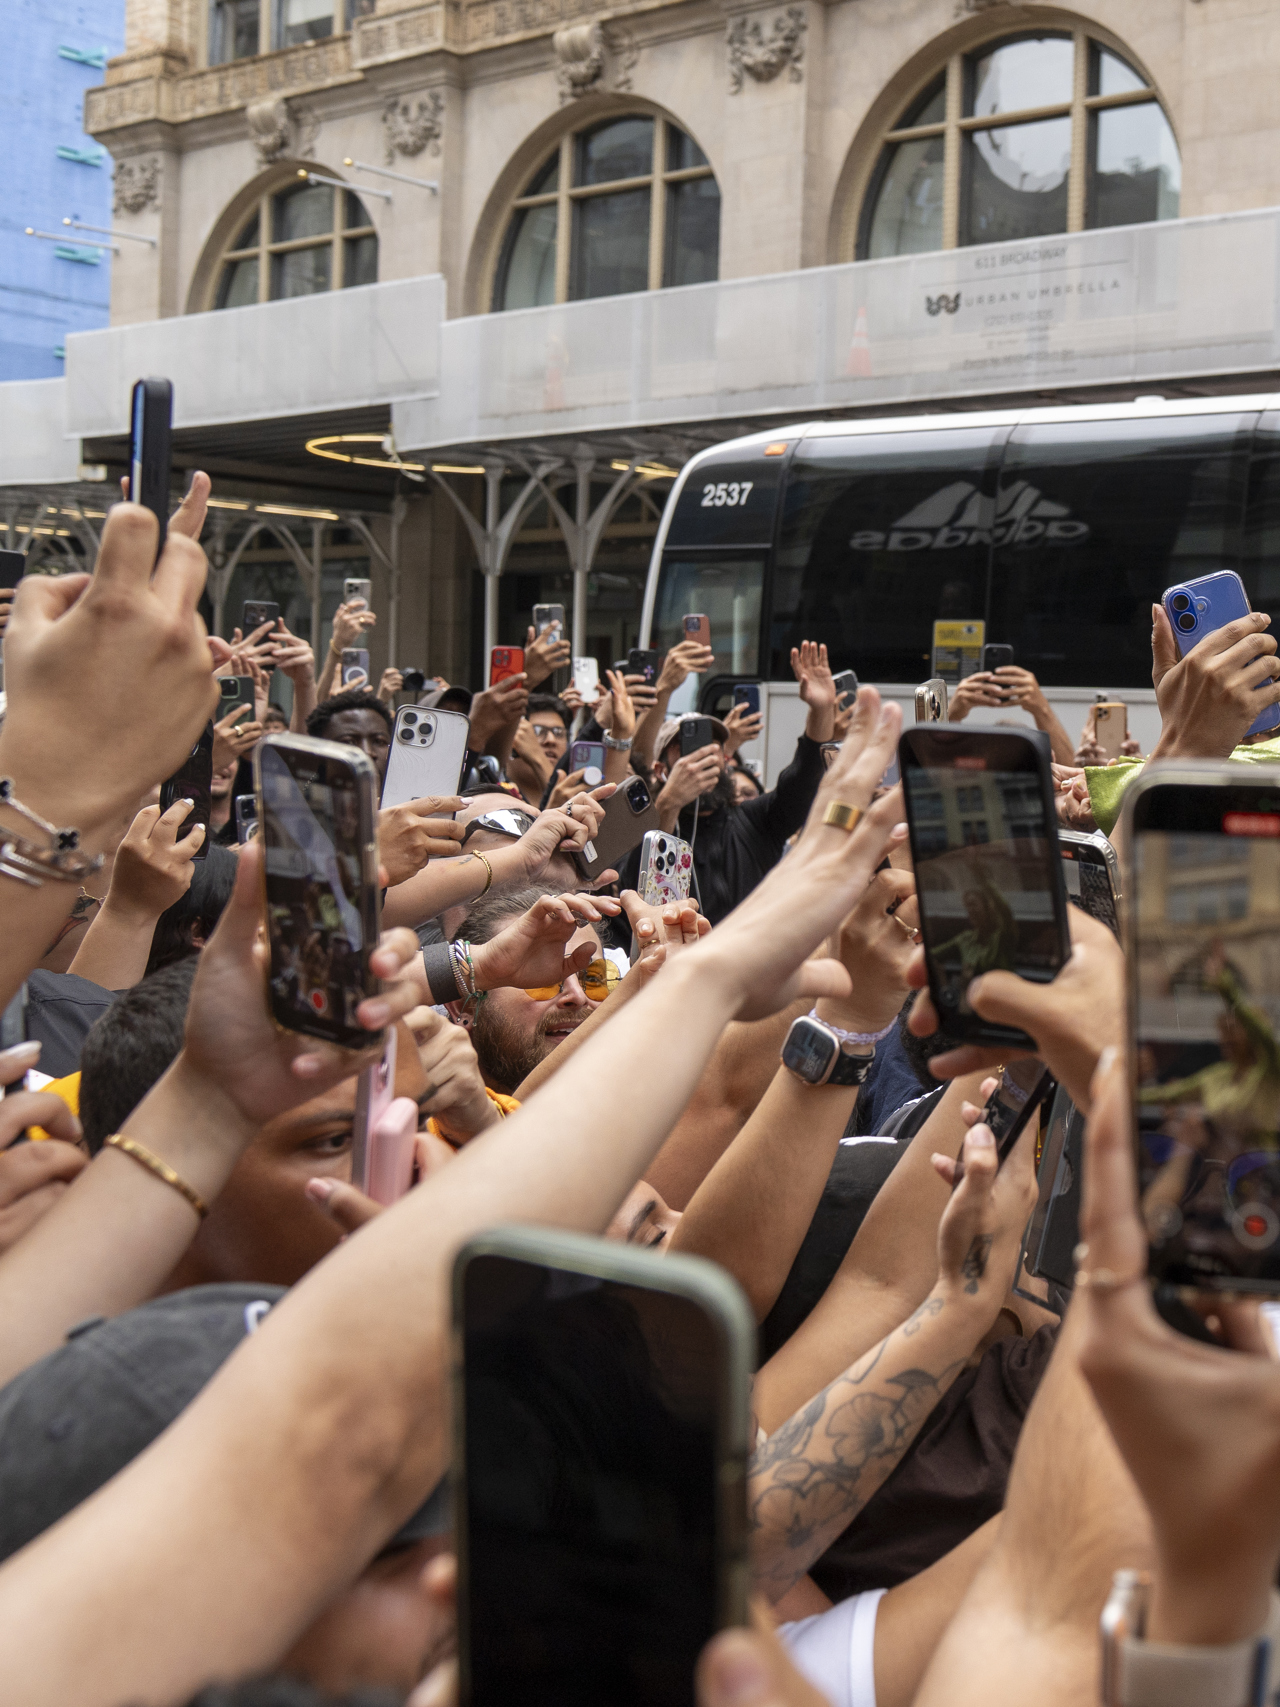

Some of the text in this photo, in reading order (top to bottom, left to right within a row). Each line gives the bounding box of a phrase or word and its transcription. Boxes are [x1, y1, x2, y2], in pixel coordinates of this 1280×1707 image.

[975, 246, 1068, 270] 611 BROADWAY
[964, 279, 1120, 307] URBAN UMBRELLA
[701, 481, 753, 507] 2537
